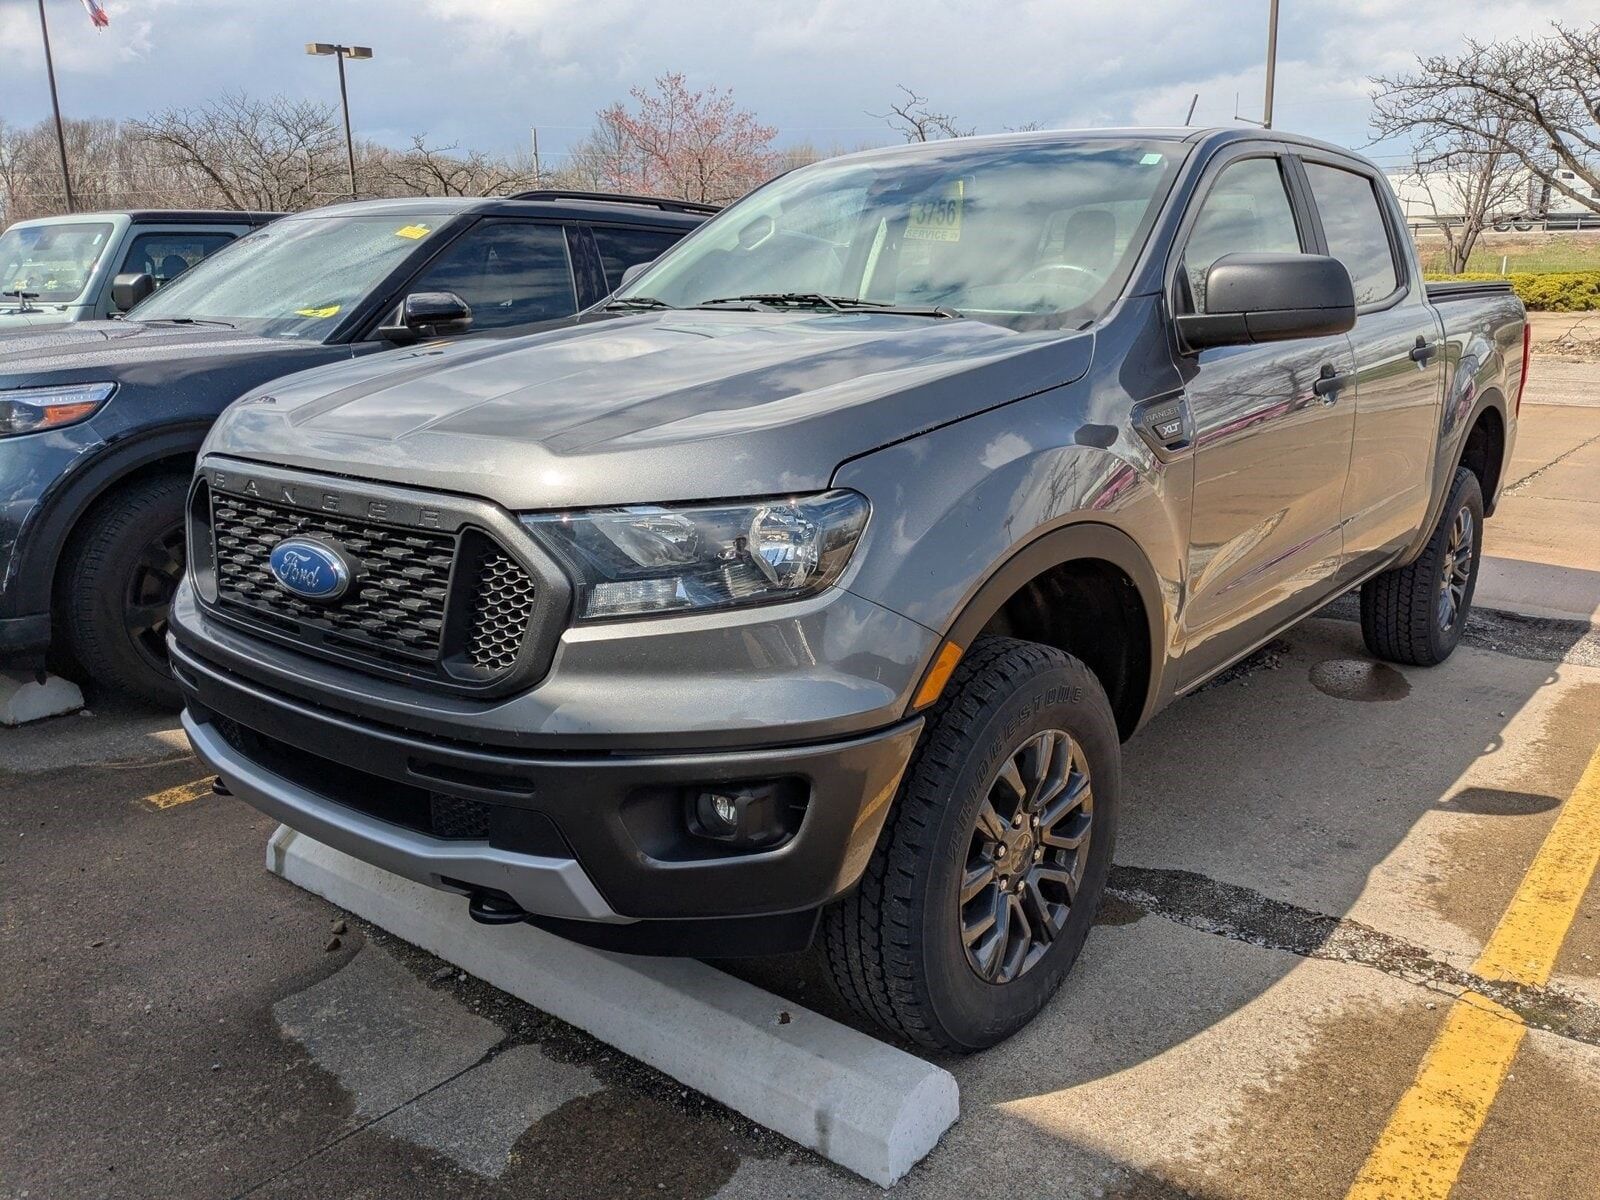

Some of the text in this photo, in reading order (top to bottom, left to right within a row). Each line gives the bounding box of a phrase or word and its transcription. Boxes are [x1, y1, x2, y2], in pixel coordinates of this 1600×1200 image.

[915, 200, 957, 226] 3756
[905, 229, 948, 240] SERVICE
[1145, 406, 1180, 423] RANGER
[1162, 421, 1180, 435] XLT
[213, 472, 440, 529] RANGER
[280, 551, 319, 588] Ford
[949, 686, 1083, 863] BRIDGESTONE
